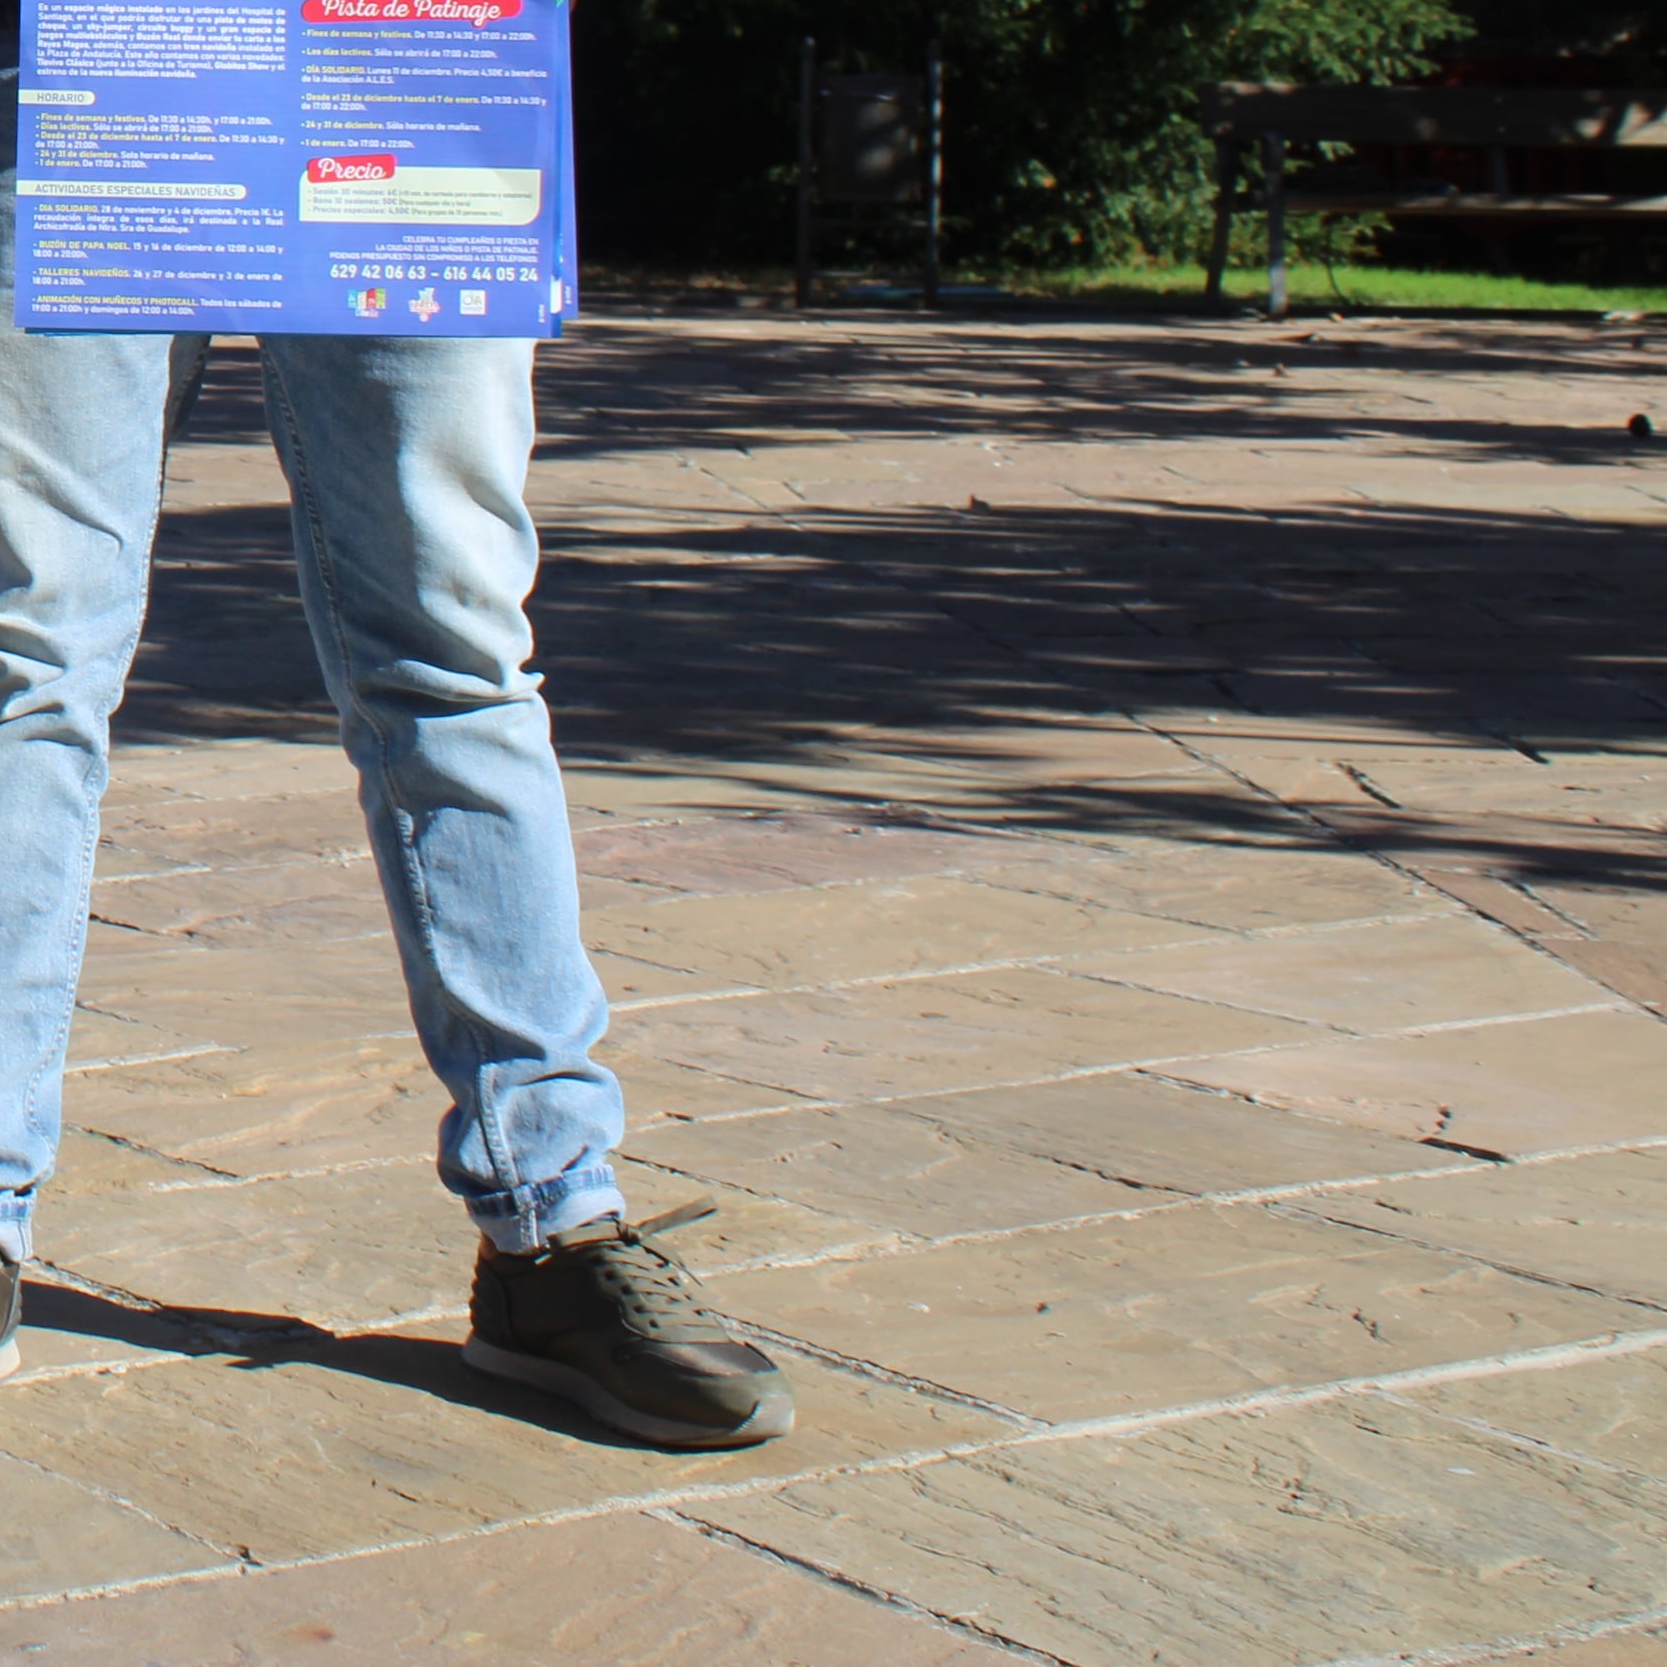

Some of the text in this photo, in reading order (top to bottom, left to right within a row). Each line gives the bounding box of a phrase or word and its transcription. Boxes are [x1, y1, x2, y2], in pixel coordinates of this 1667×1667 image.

[37, 92, 84, 103] HORARIO
[318, 158, 386, 179] Precio
[35, 184, 235, 197] ACTIVIDADES ESPECIALES NAVIDEÑAS
[330, 264, 357, 279] 629
[362, 264, 381, 279] 42
[385, 265, 403, 279] 06
[407, 265, 426, 279] 63
[443, 265, 467, 280] 616
[472, 266, 491, 280] 44
[496, 266, 515, 281] 05
[519, 267, 538, 282] 24
